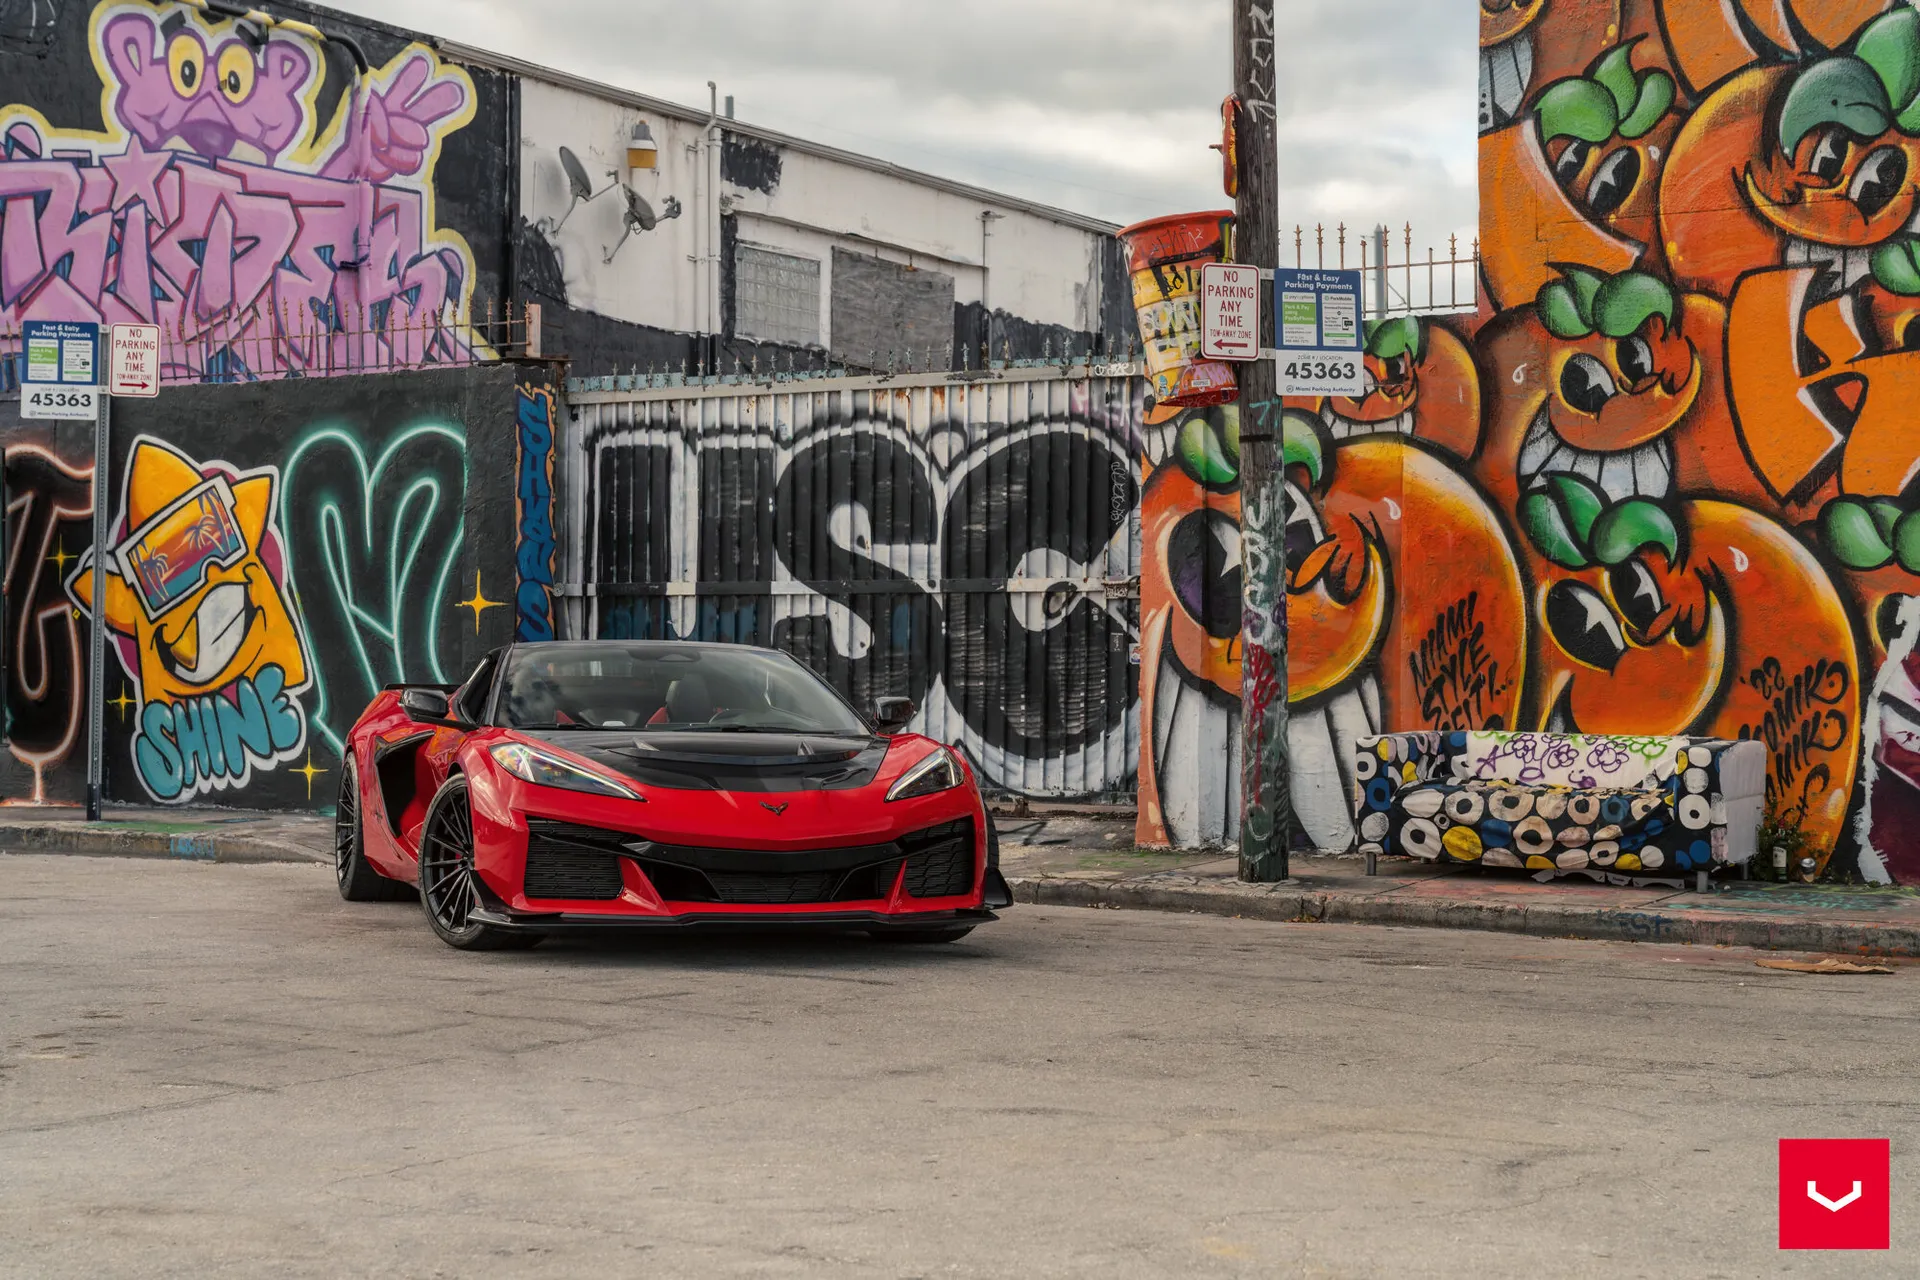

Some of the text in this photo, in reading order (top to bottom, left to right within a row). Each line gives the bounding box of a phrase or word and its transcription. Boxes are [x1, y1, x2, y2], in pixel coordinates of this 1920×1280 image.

[1223, 270, 1239, 282] NO
[1314, 273, 1320, 281] &
[1322, 274, 1340, 283] Easy
[1207, 285, 1254, 299] PARKING
[1284, 281, 1353, 291] Parking Payments
[1220, 300, 1242, 313] ANY
[1219, 315, 1243, 327] TIME
[31, 330, 57, 338] Parking
[129, 328, 142, 338] NO
[1210, 329, 1252, 339] TOW-AWAY ZONE
[115, 340, 156, 350] PARKING
[125, 351, 145, 361] ANY
[125, 362, 145, 372] TIME
[1284, 362, 1356, 380] 45363
[30, 393, 92, 407] 45363
[1408, 590, 1478, 705] MIAMI
[1422, 621, 1491, 731] STYLE
[1738, 658, 1849, 752] OMIK
[135, 662, 302, 800] SHINE
